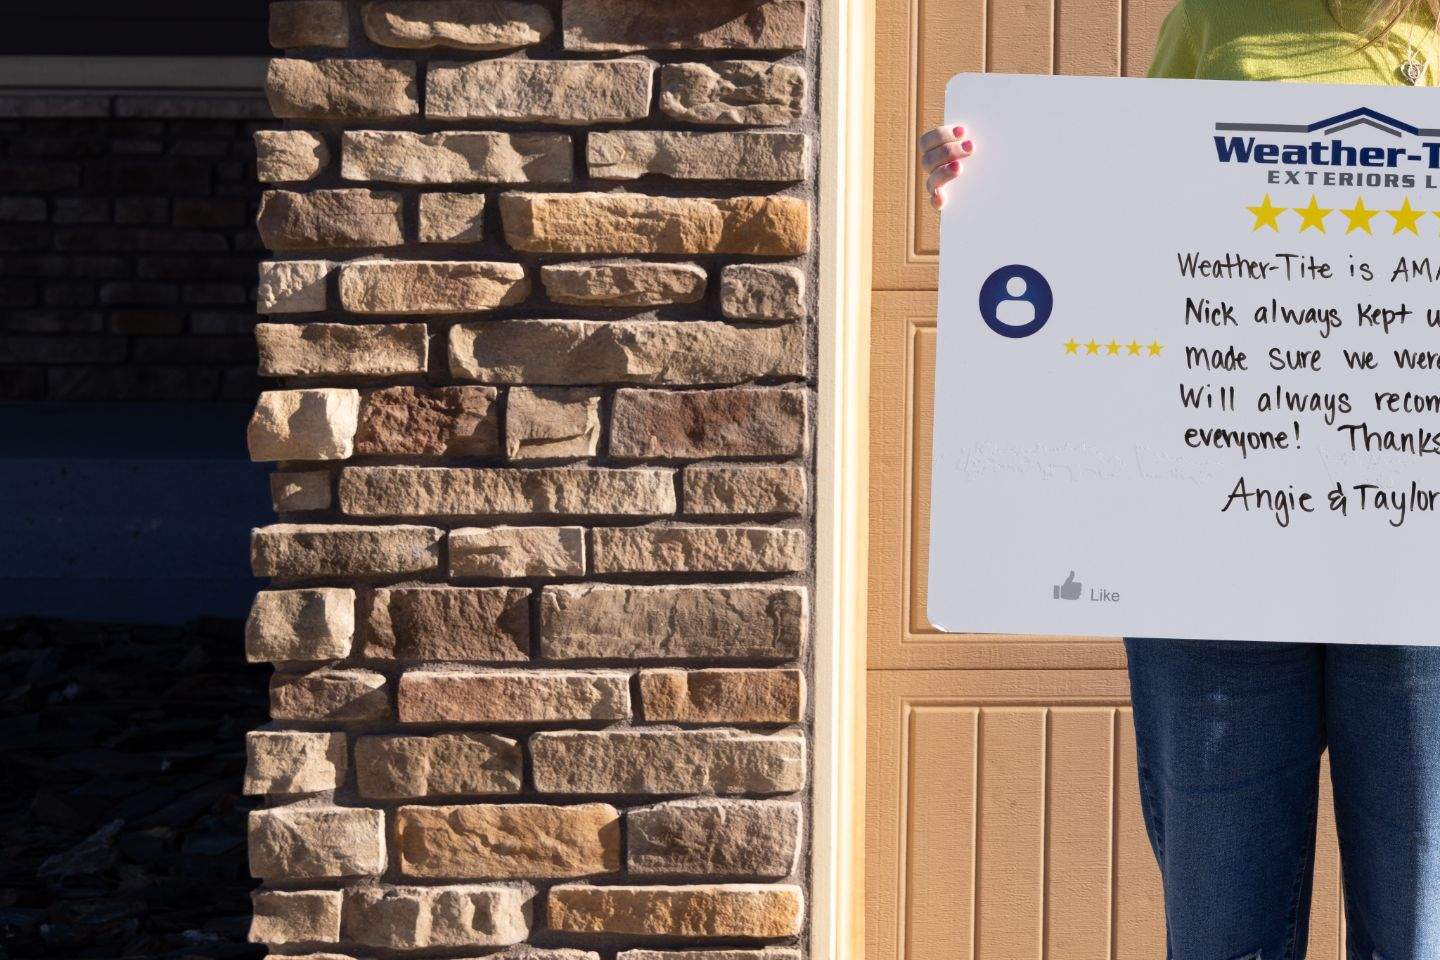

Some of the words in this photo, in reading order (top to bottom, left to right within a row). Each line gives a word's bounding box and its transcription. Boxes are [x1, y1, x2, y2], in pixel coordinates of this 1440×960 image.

[1267, 169, 1416, 189] EXTERIORS
[1176, 251, 1333, 282] Weather-Tite
[1348, 253, 1374, 282] is
[1184, 297, 1239, 327] Nick
[1253, 298, 1343, 339] always
[1185, 344, 1249, 372] made
[1268, 347, 1322, 372] sure
[1342, 349, 1379, 371] we
[1179, 383, 1235, 412] Will
[1257, 384, 1353, 426] always
[1183, 420, 1301, 460] everyone!
[1220, 476, 1315, 528] Angie
[1327, 481, 1348, 517] &
[1352, 480, 1440, 528] Taylor
[1090, 588, 1120, 602] Like
